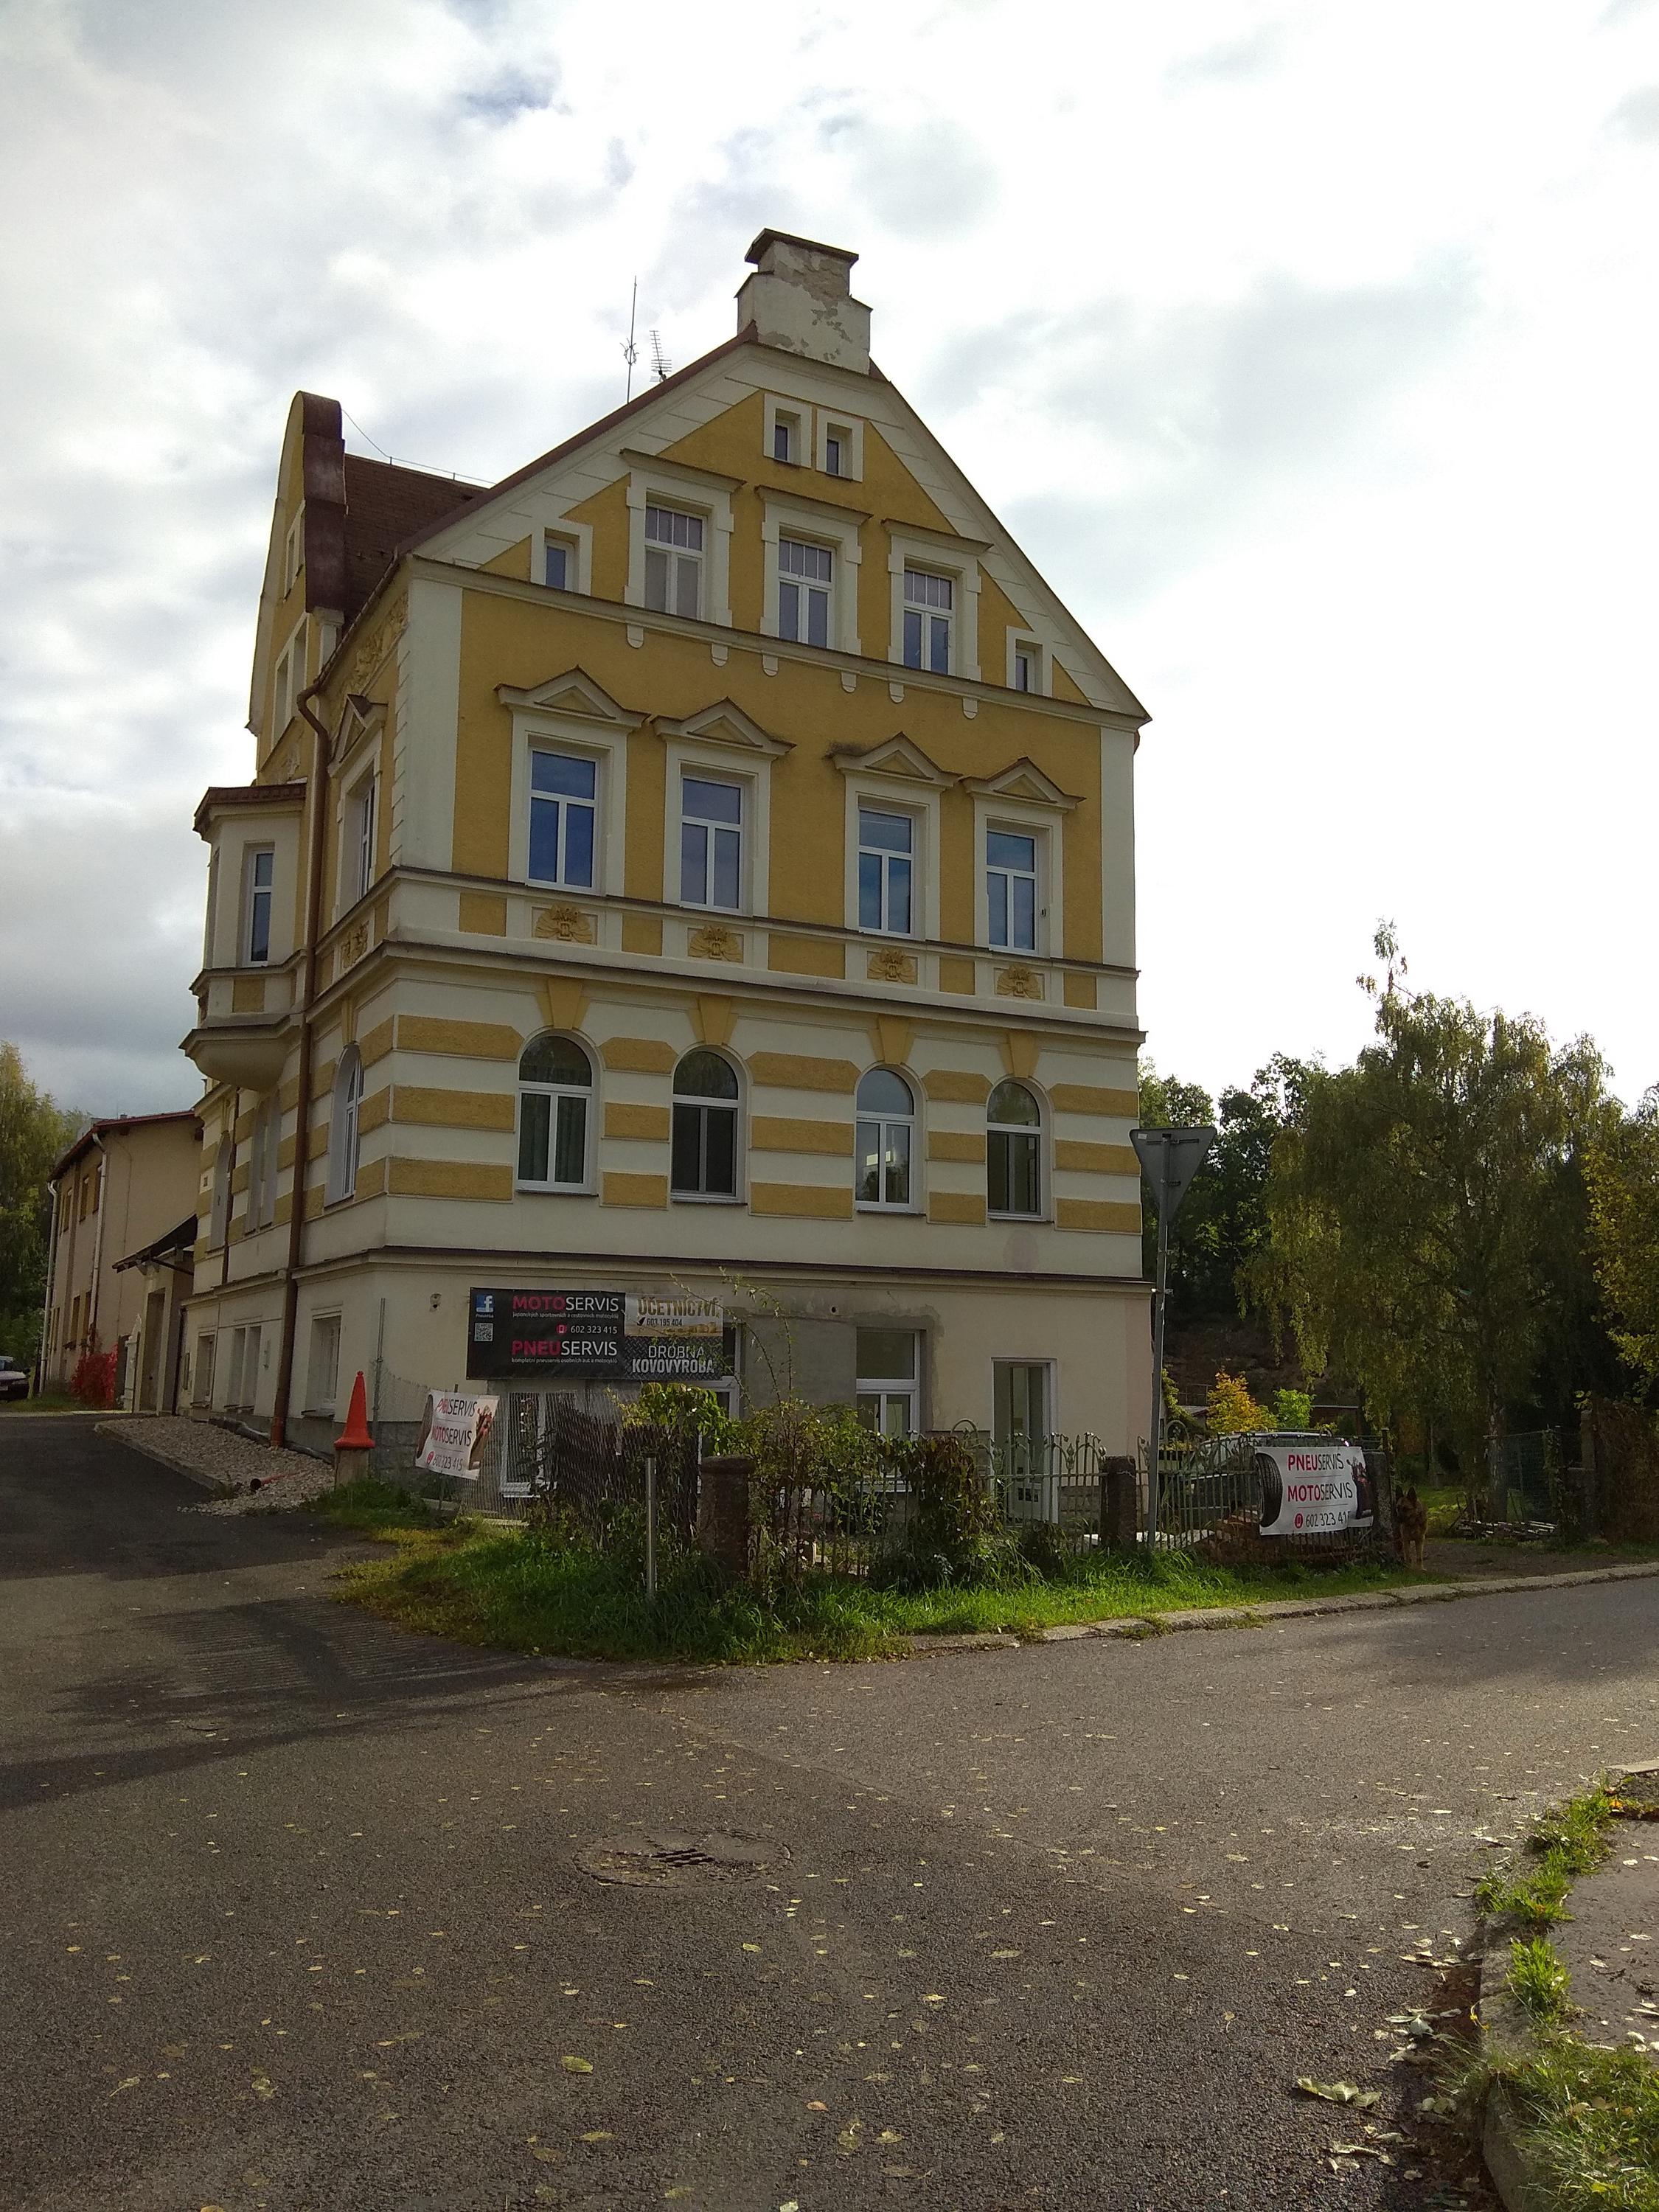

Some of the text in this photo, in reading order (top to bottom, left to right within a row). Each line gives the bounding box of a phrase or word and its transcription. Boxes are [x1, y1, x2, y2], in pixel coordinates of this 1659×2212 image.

[512, 1295, 619, 1312] MOTOSERVIS
[570, 1325, 618, 1335] 602 323 415
[647, 1318, 683, 1326] 603 195 404
[512, 1340, 617, 1357] PNEUSERVIS
[452, 1458, 463, 1472] 415
[1288, 1453, 1344, 1471] PNEUSERVIS
[1287, 1482, 1353, 1503] MOTOSERVIS
[1305, 1513, 1319, 1528] 602
[1319, 1512, 1336, 1526] 323
